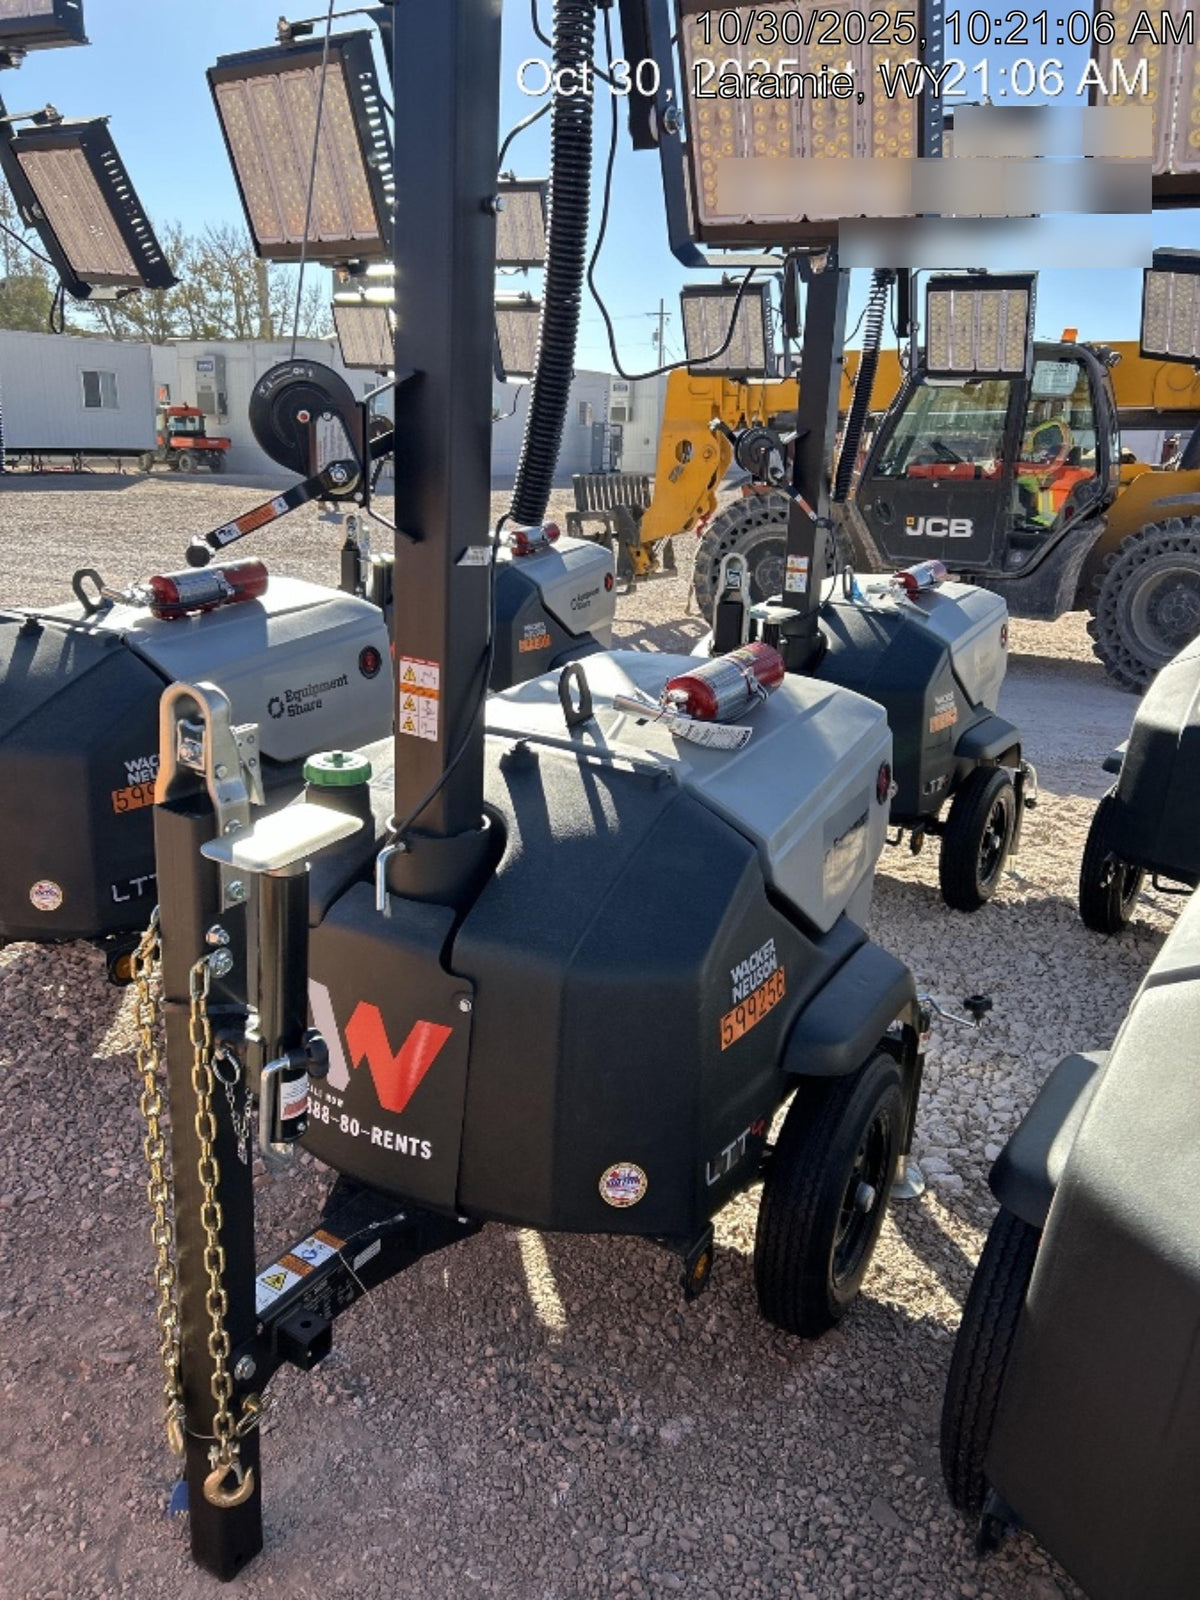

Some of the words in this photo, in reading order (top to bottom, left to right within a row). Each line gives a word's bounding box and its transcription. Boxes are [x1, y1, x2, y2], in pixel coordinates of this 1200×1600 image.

[906, 516, 974, 538] JCB
[284, 674, 349, 703] Equipment
[287, 699, 323, 718] Share
[124, 754, 159, 772] WAC
[127, 768, 157, 786] NEU
[116, 782, 155, 811] 599
[730, 938, 776, 985] WACKER
[731, 953, 778, 1004] NEUSON
